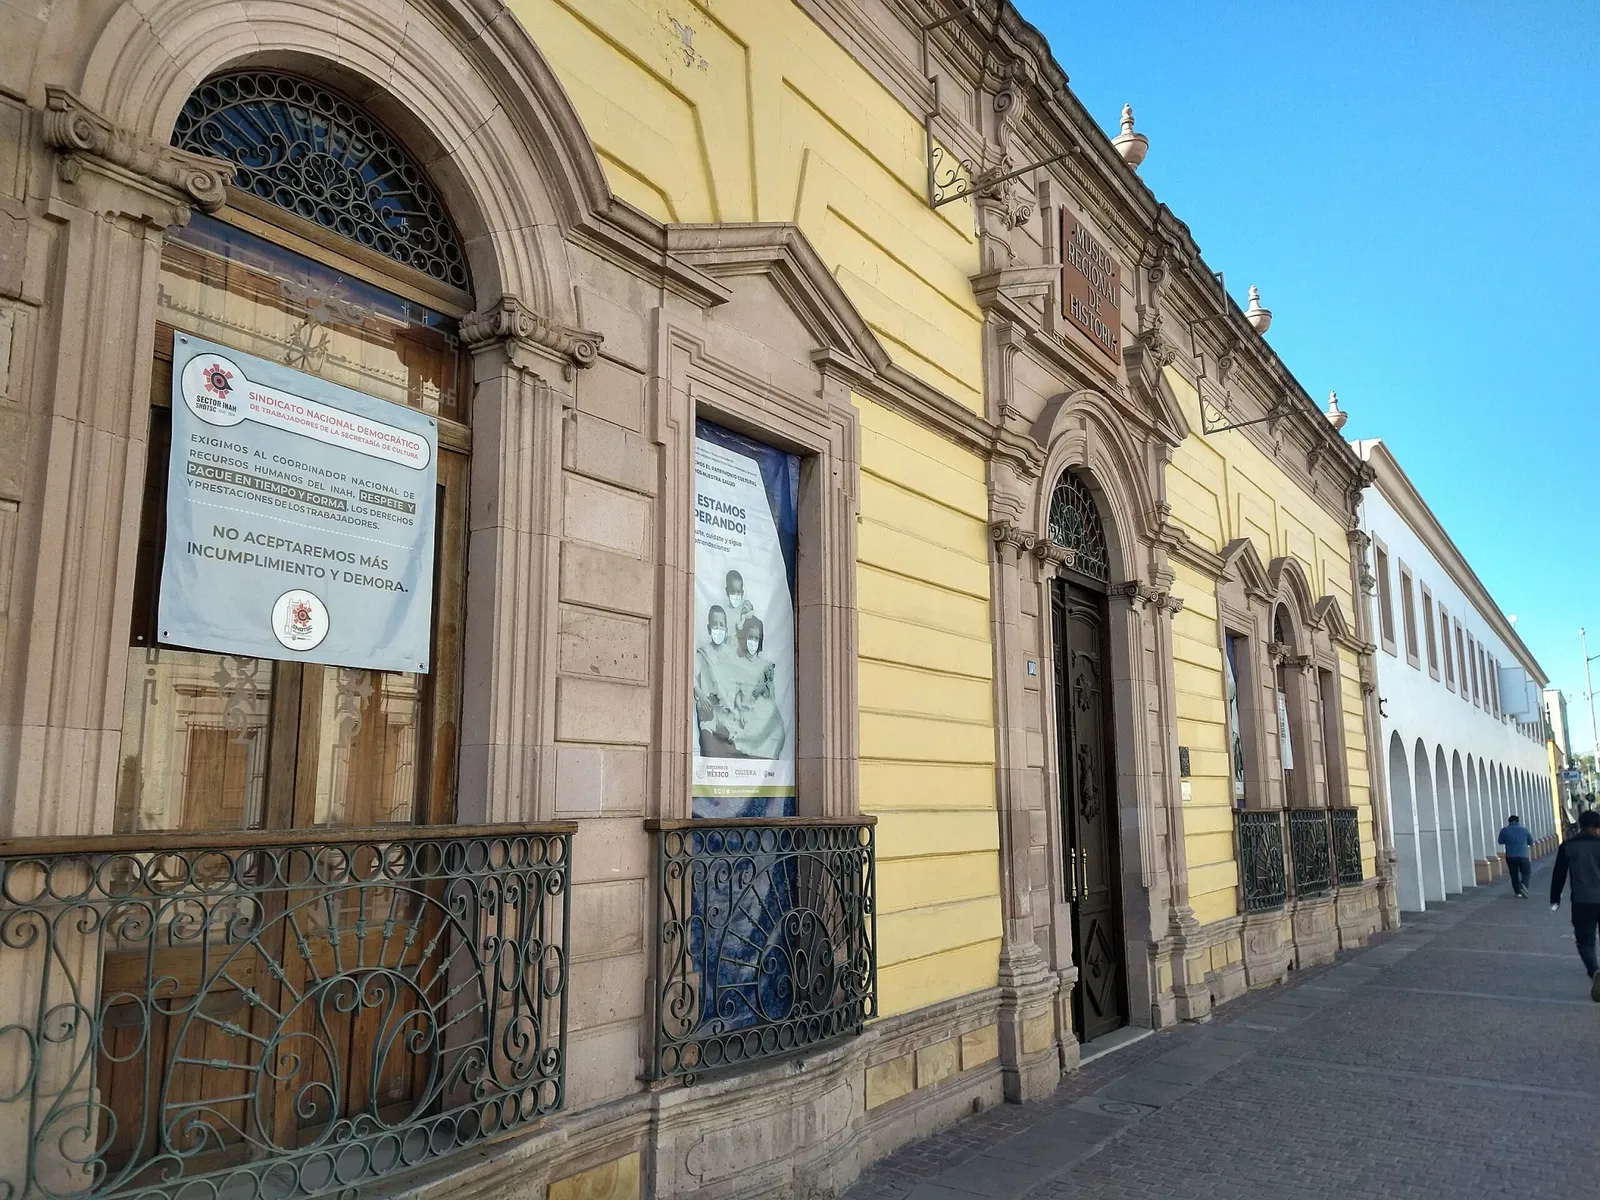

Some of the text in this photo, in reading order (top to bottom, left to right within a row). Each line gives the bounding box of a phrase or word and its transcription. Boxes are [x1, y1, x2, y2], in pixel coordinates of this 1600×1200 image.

[1067, 240, 1119, 310] REGIONAL
[1076, 223, 1113, 277] MUSEO
[1070, 293, 1118, 355] HISTORIA
[1087, 286, 1102, 316] DE
[196, 395, 237, 412] SECTOR INAH
[249, 391, 420, 451] SINDICATO NACIONAL DEMOCRÁTICO
[249, 403, 419, 460] DE TRABAJADORES DE LA SECRETARÍA DE CULTURA
[189, 449, 415, 513] RECURSOS HUMANOS DEL INAH, RESPETE Y
[191, 433, 415, 500] EXIGIMOS AL COORDINADOR NACIONAL DE
[187, 478, 380, 530] Y PRESTACIONES DE LOS TRABAJADORES.
[188, 463, 414, 526] PAGUE EN TIEMPO Y FORMA, LOS DERECHOS
[697, 493, 746, 520] ESTAMOS
[187, 541, 409, 593] INCUMPLIMIENTO Y DEMORA.
[212, 525, 389, 571] NO ACEPTAREMOS MÁS
